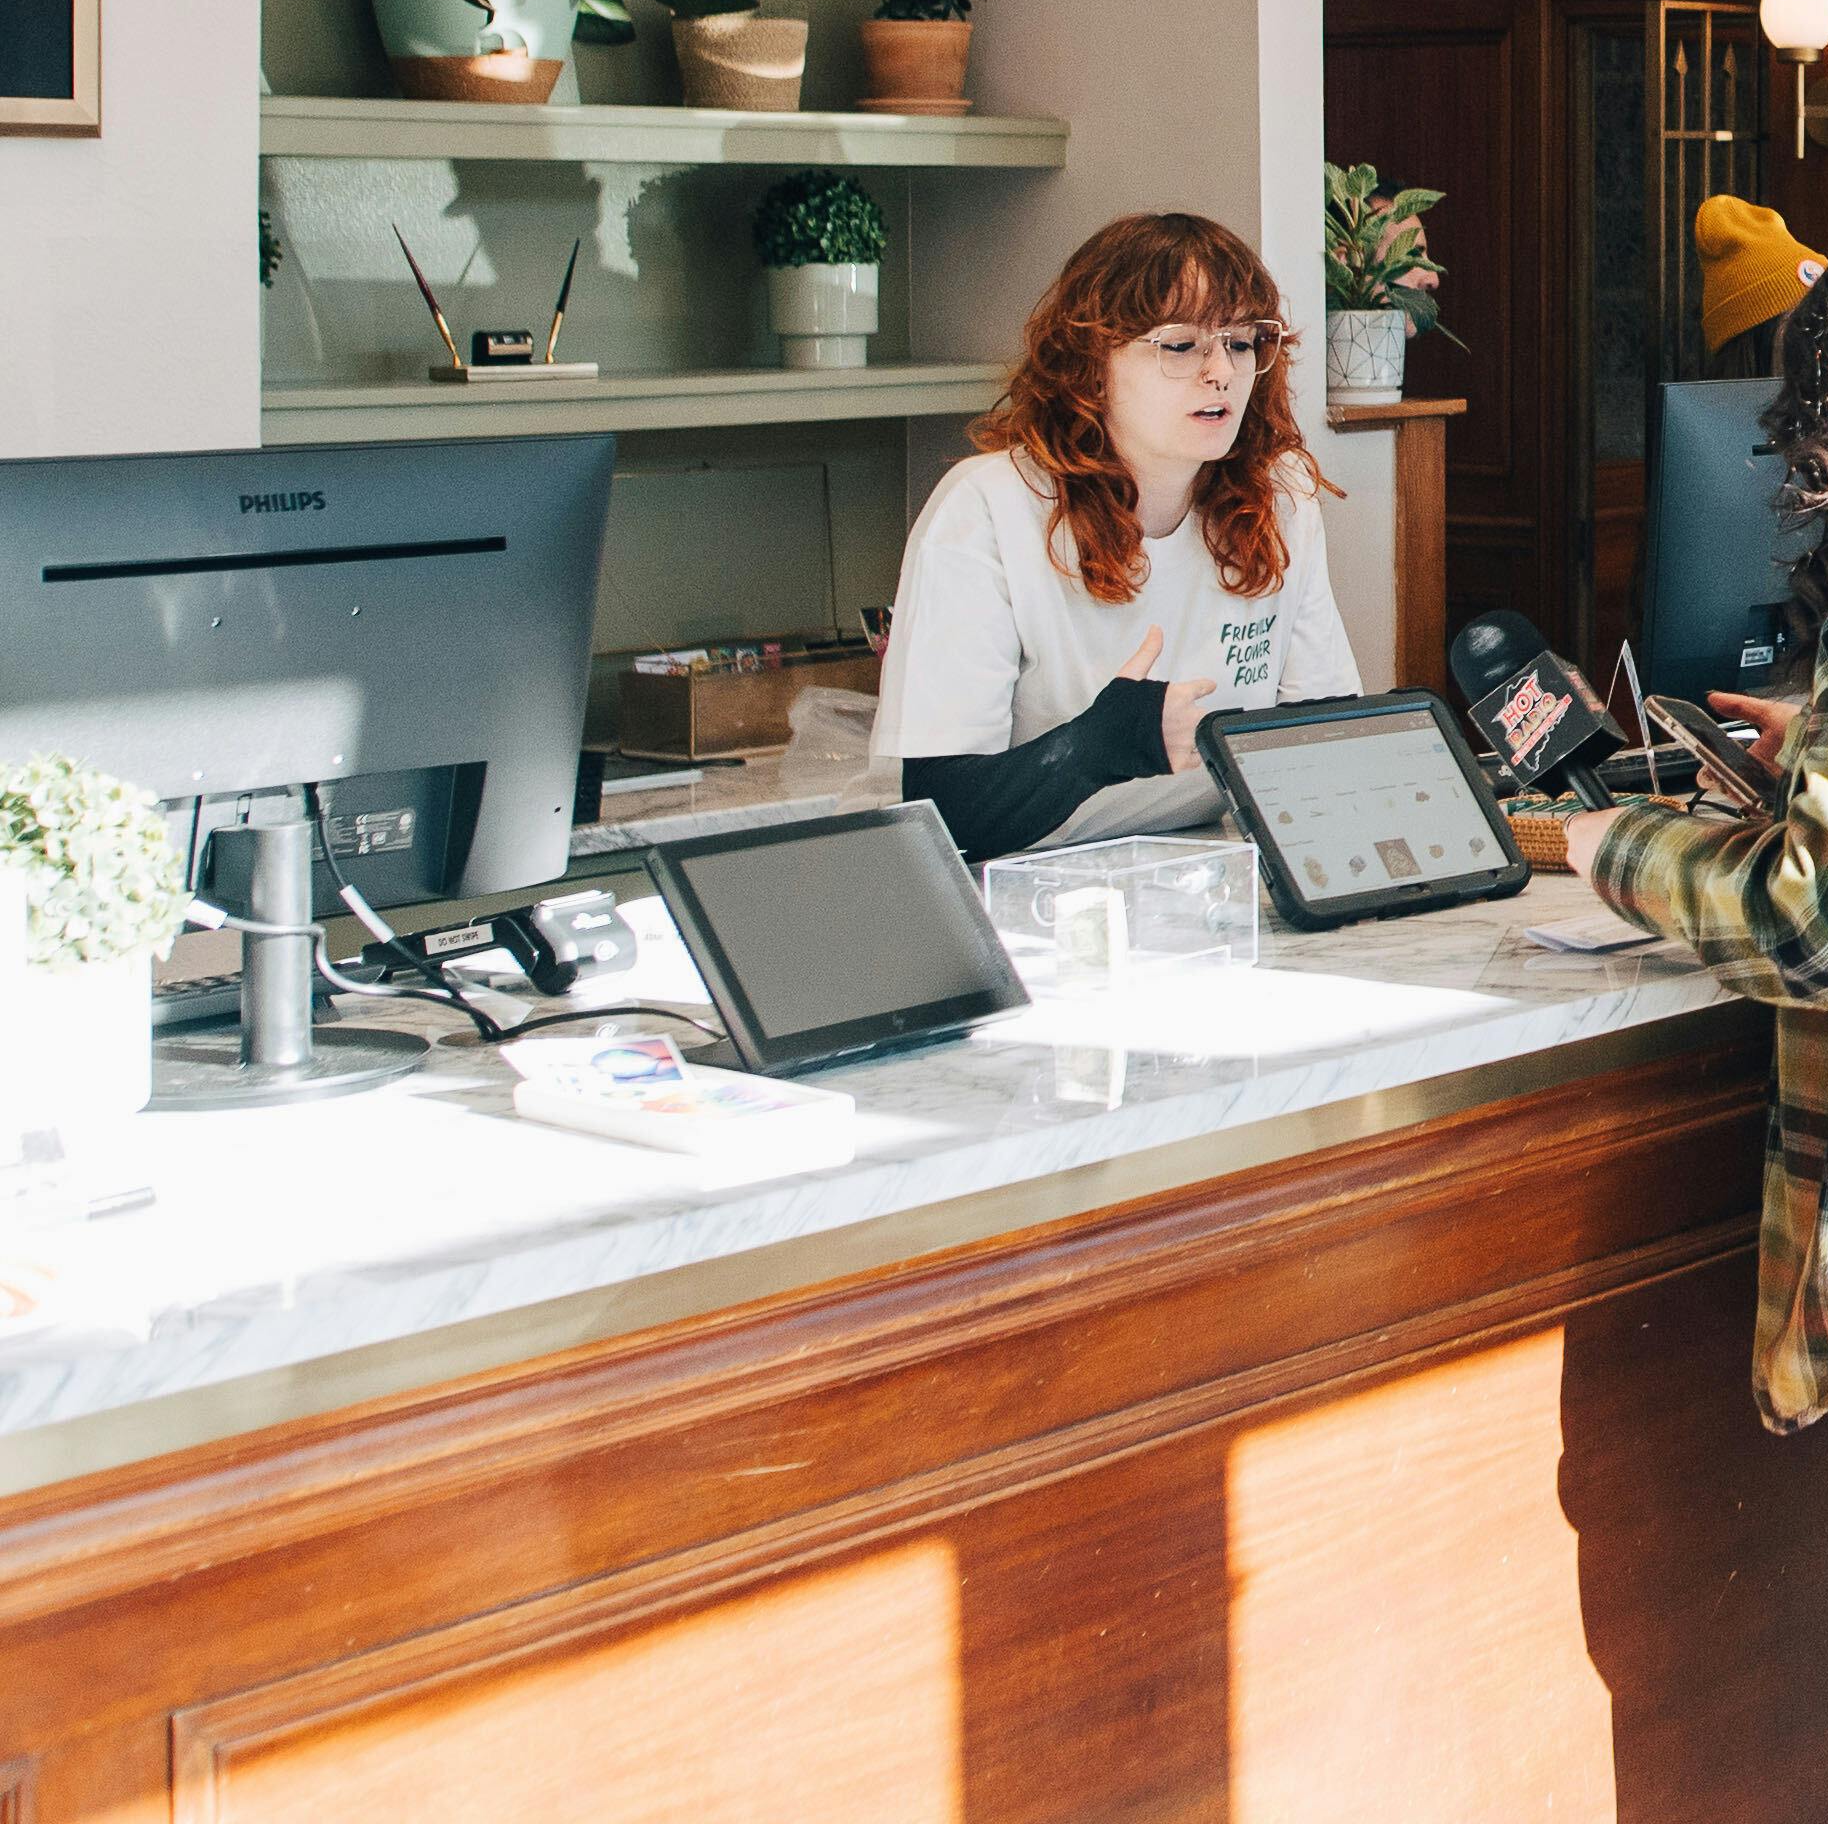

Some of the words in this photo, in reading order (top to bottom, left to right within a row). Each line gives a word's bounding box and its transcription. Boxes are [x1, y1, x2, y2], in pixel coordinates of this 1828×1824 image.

[240, 491, 326, 514] PHILIPS
[1220, 614, 1277, 644] FRIELY
[1233, 663, 1268, 688] FOLKS
[1501, 676, 1542, 733] HOT
